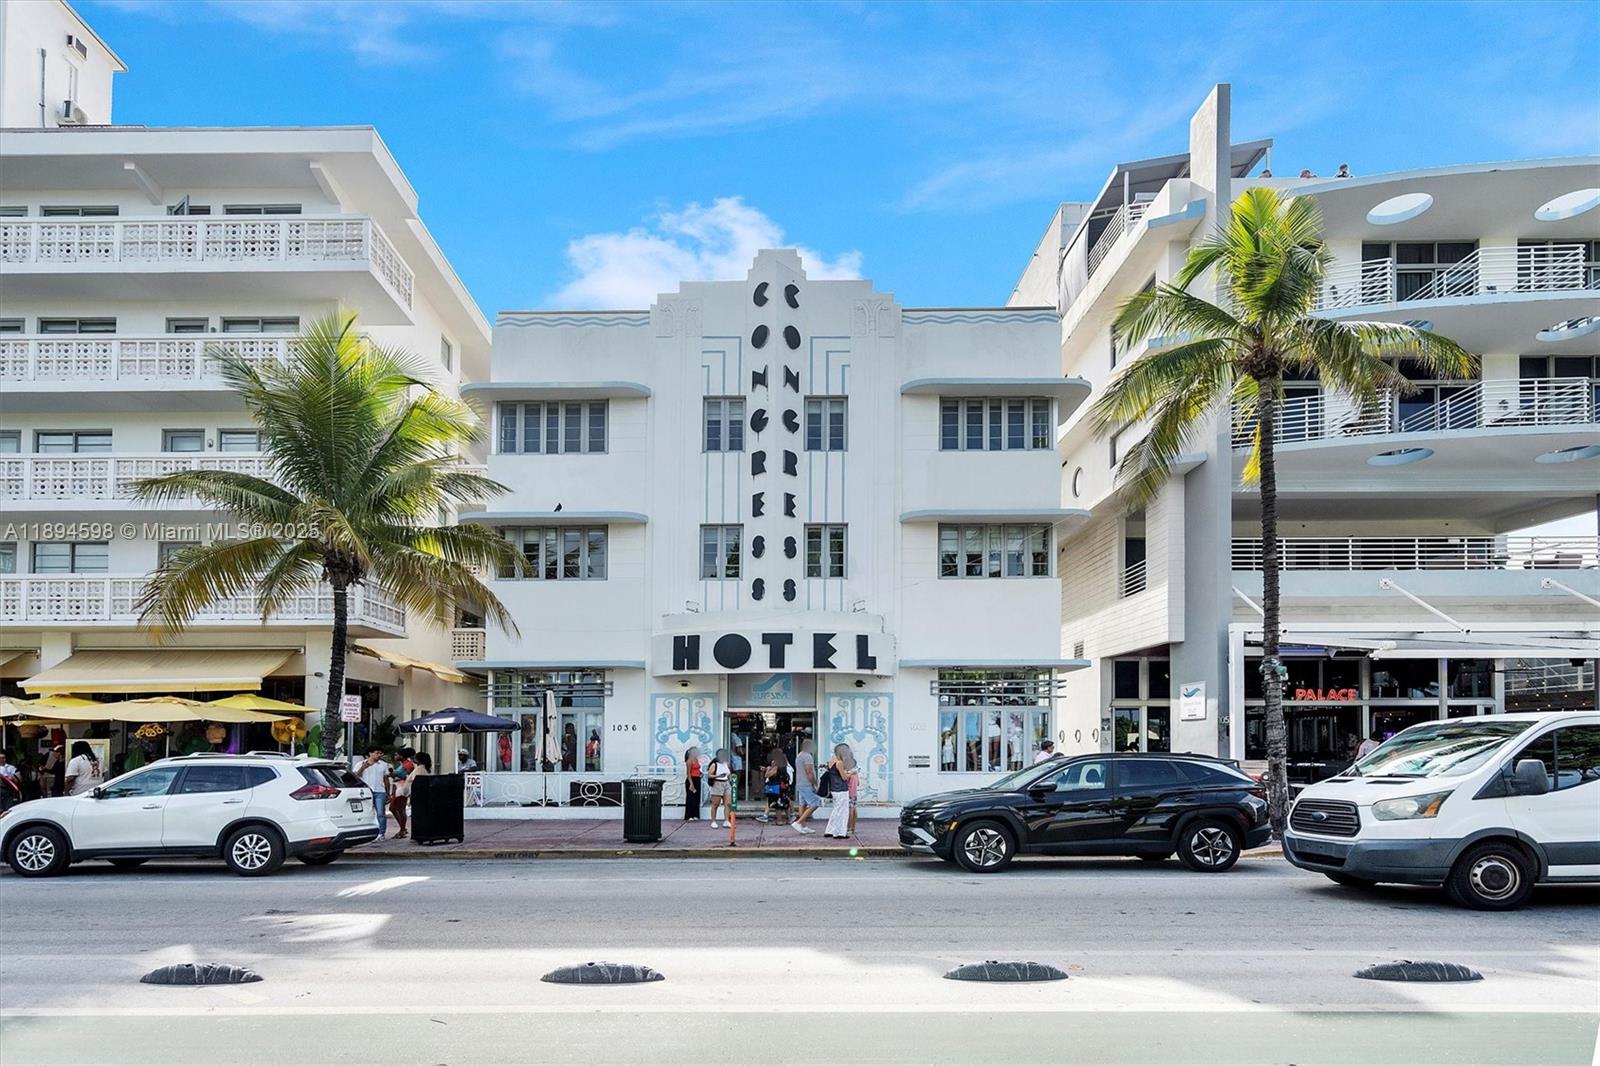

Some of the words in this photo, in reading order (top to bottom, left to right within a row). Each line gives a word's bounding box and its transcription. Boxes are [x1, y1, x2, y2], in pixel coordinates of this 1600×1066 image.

[750, 281, 769, 602] CONGRESS
[783, 283, 801, 602] CONGRESS
[672, 632, 877, 671] HOTEL
[1295, 688, 1358, 701] PALACE
[413, 724, 447, 732] VALET
